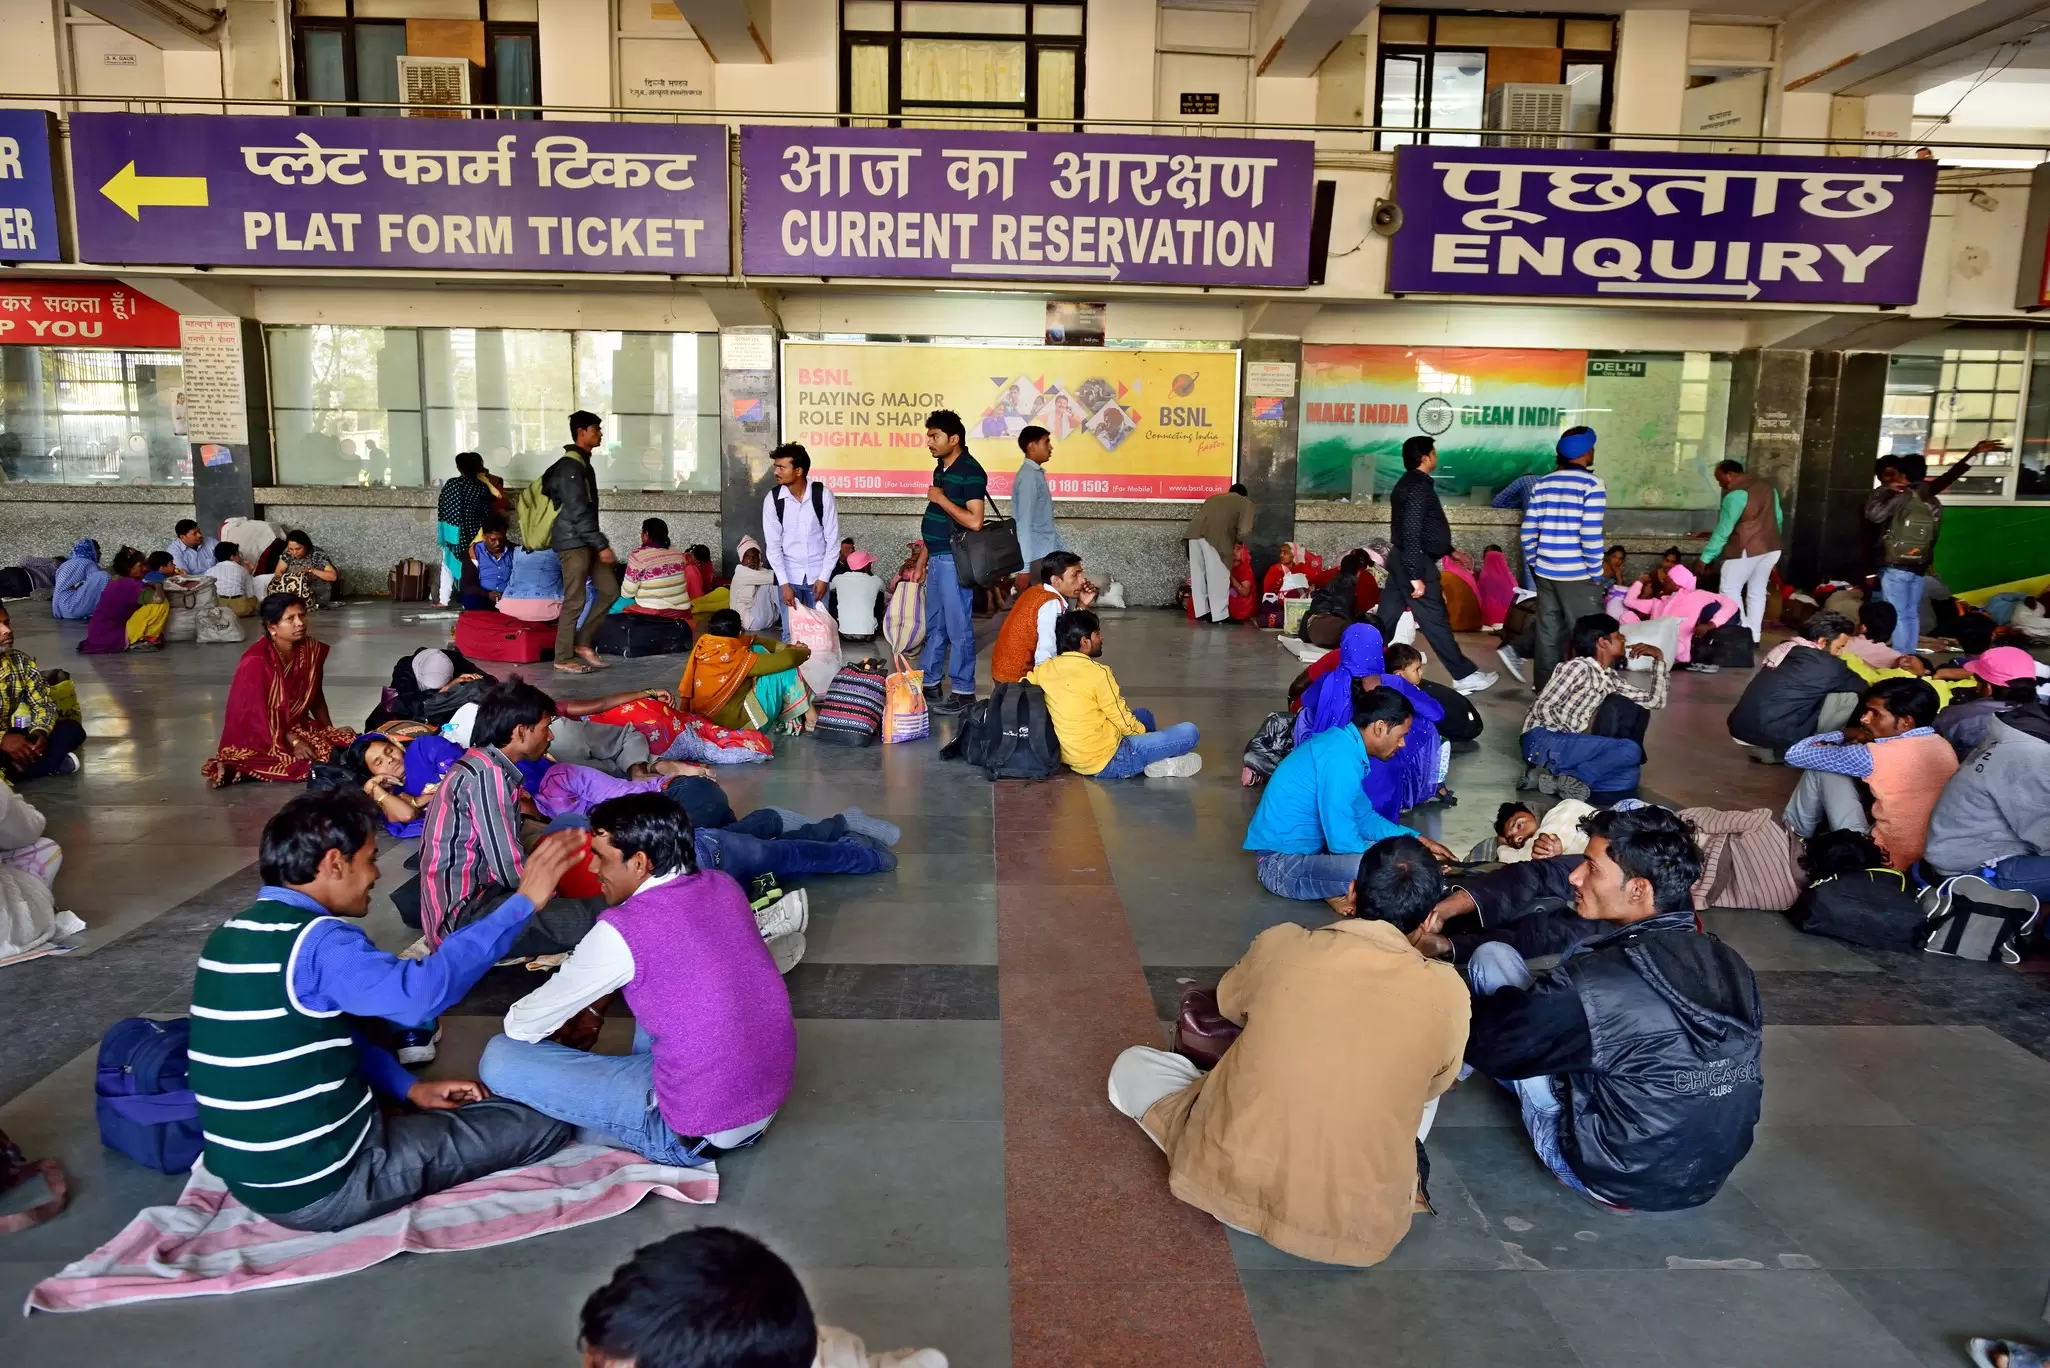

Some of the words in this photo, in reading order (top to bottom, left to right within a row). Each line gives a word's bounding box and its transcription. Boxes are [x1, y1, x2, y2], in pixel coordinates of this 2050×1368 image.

[240, 132, 369, 185] प्लेट
[379, 135, 516, 186] फार्म
[532, 136, 697, 191] टिकट
[780, 145, 922, 199] आज
[942, 149, 1027, 201] का
[1050, 152, 1278, 209] आरक्षण
[1433, 162, 1904, 231] पूछताछ
[243, 211, 362, 252] PLAT
[379, 214, 513, 254] FORM
[528, 216, 705, 258] TICKET
[781, 209, 978, 259] CURRENT
[992, 214, 1274, 267] RESERVATION
[1432, 233, 1894, 283] ENQUIRY
[42, 297, 100, 313] सकता
[28, 320, 103, 338] YOU
[1592, 362, 1641, 372] DELHI
[798, 368, 853, 386] BSNL
[799, 391, 875, 407] PLAYING
[881, 393, 944, 408] MAJOR
[799, 410, 844, 426] ROLE
[850, 411, 870, 426] IN
[1160, 406, 1213, 427] BSNL
[1306, 402, 1356, 424] MAKE
[1359, 404, 1409, 425] INDIA
[1460, 406, 1514, 426] CLEAN
[1145, 430, 1193, 443] Connecting
[1195, 431, 1219, 441] India
[829, 475, 851, 489] 345
[853, 476, 882, 489] 1500
[884, 482, 898, 490] (For
[1059, 480, 1079, 492] 180
[1081, 480, 1109, 493] 1503
[1112, 485, 1126, 494] (For
[1127, 486, 1153, 494] Mobile)
[1168, 485, 1222, 493] www.bsnl.co.in
[1675, 1060, 1756, 1092] CHICAGO
[1709, 1085, 1733, 1097] CLUBS
